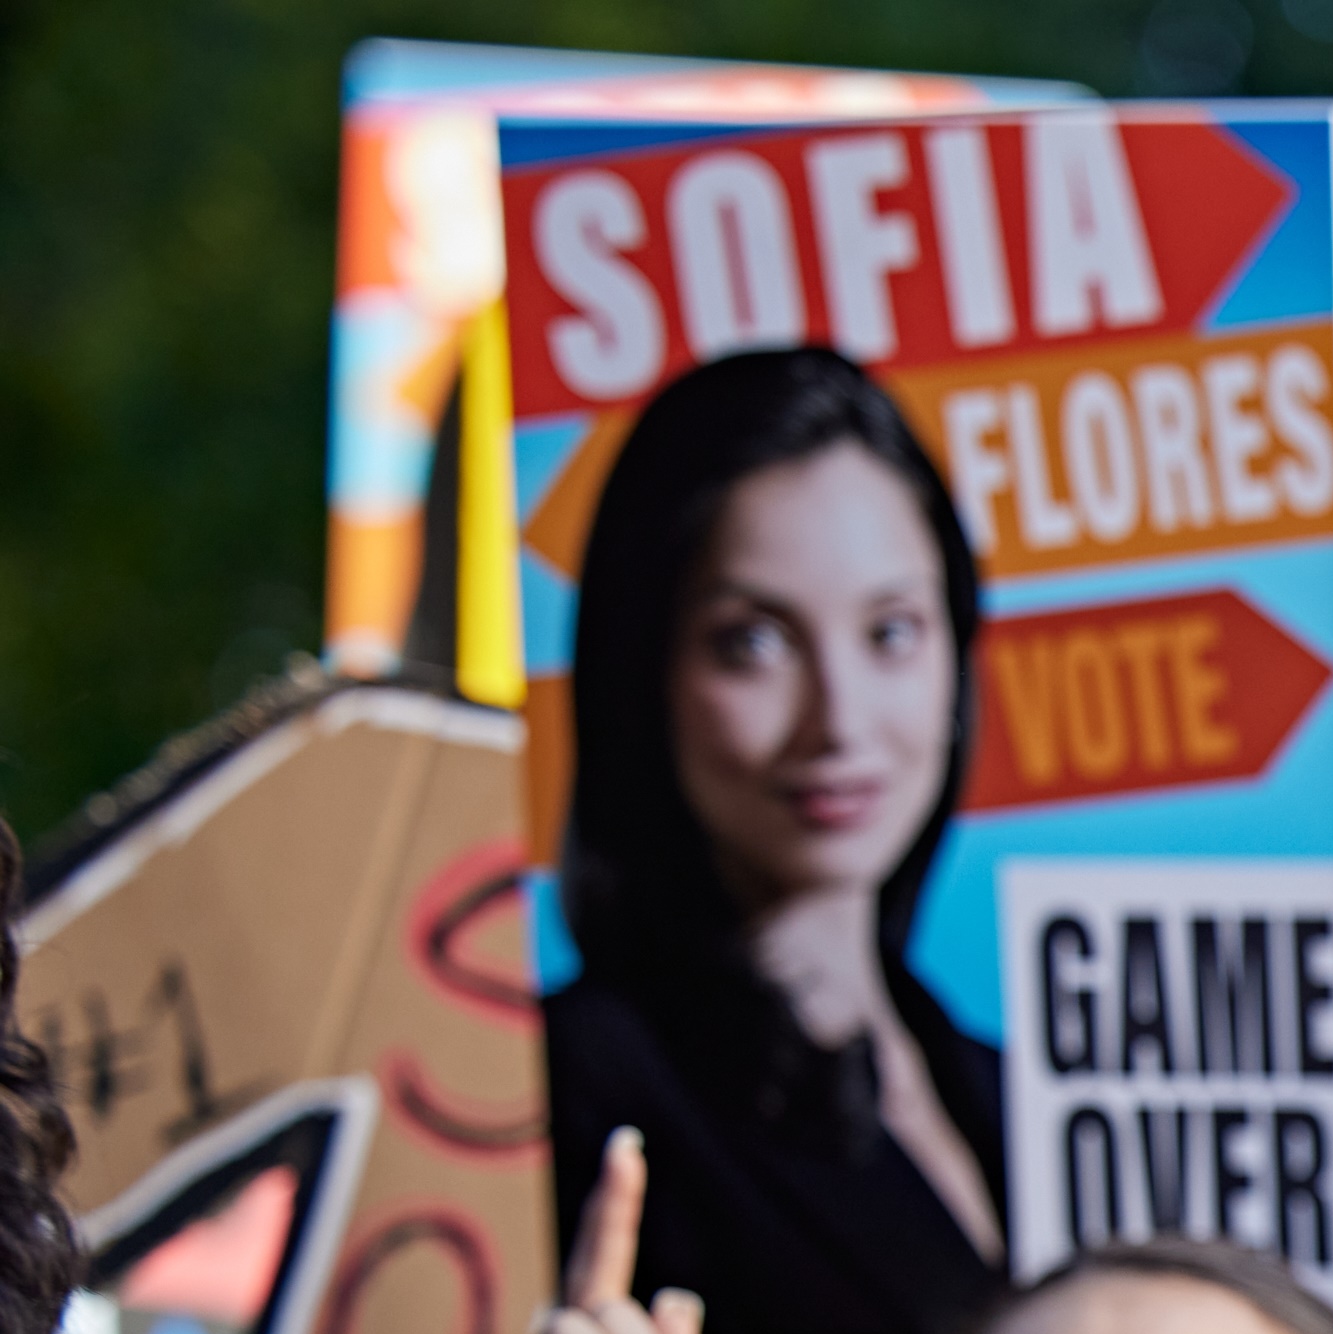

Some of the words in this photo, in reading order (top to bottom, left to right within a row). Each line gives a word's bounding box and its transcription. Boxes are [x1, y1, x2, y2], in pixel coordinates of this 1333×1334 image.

[530, 108, 1166, 402] SOFIA
[987, 612, 1238, 787] VOTE
[1064, 1103, 1332, 1268] OVER
